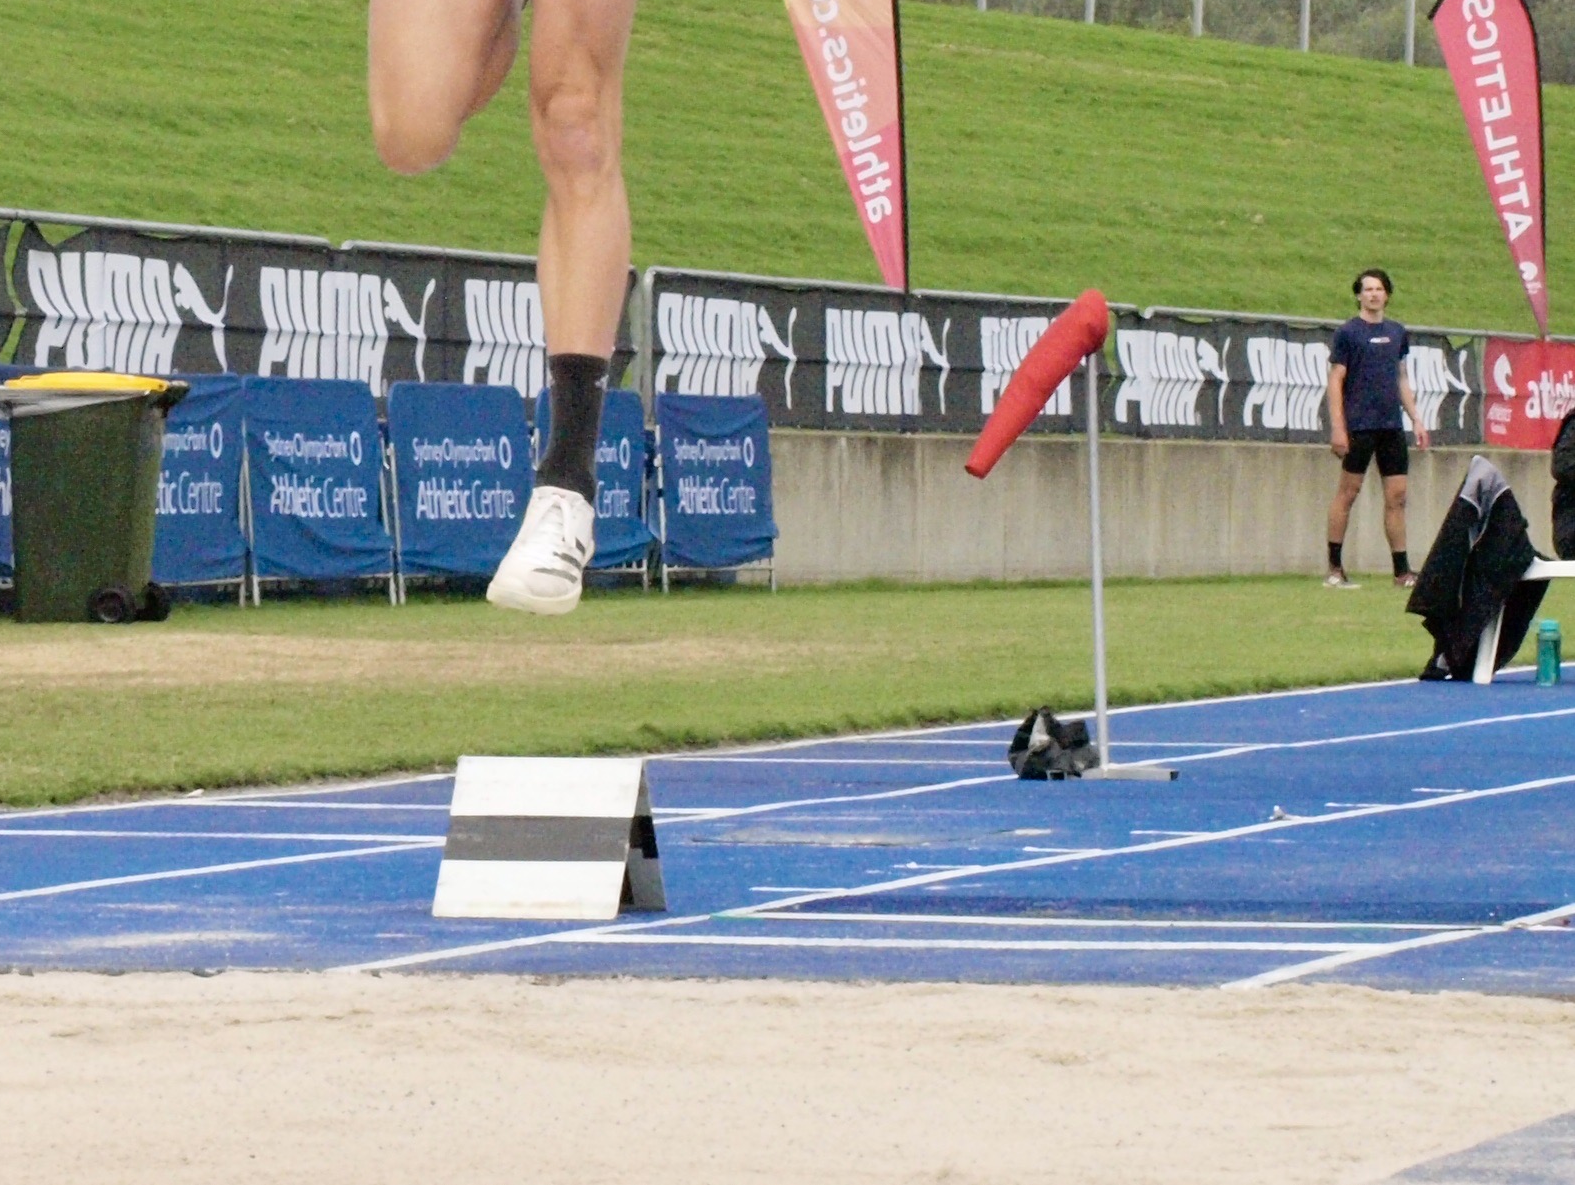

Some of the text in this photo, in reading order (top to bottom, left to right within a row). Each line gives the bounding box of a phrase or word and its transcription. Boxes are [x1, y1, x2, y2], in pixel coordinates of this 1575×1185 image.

[27, 249, 182, 375] PUMA
[258, 266, 388, 398] PUMA
[655, 292, 766, 396] PUMA
[825, 308, 923, 415] PUMA
[1115, 329, 1204, 426] PUMA
[178, 470, 223, 515] Centre
[270, 472, 368, 518] Athletic Centre
[416, 476, 516, 520] Athletic Centre
[595, 480, 629, 519] Centre
[677, 474, 756, 515] Athletic Centre
